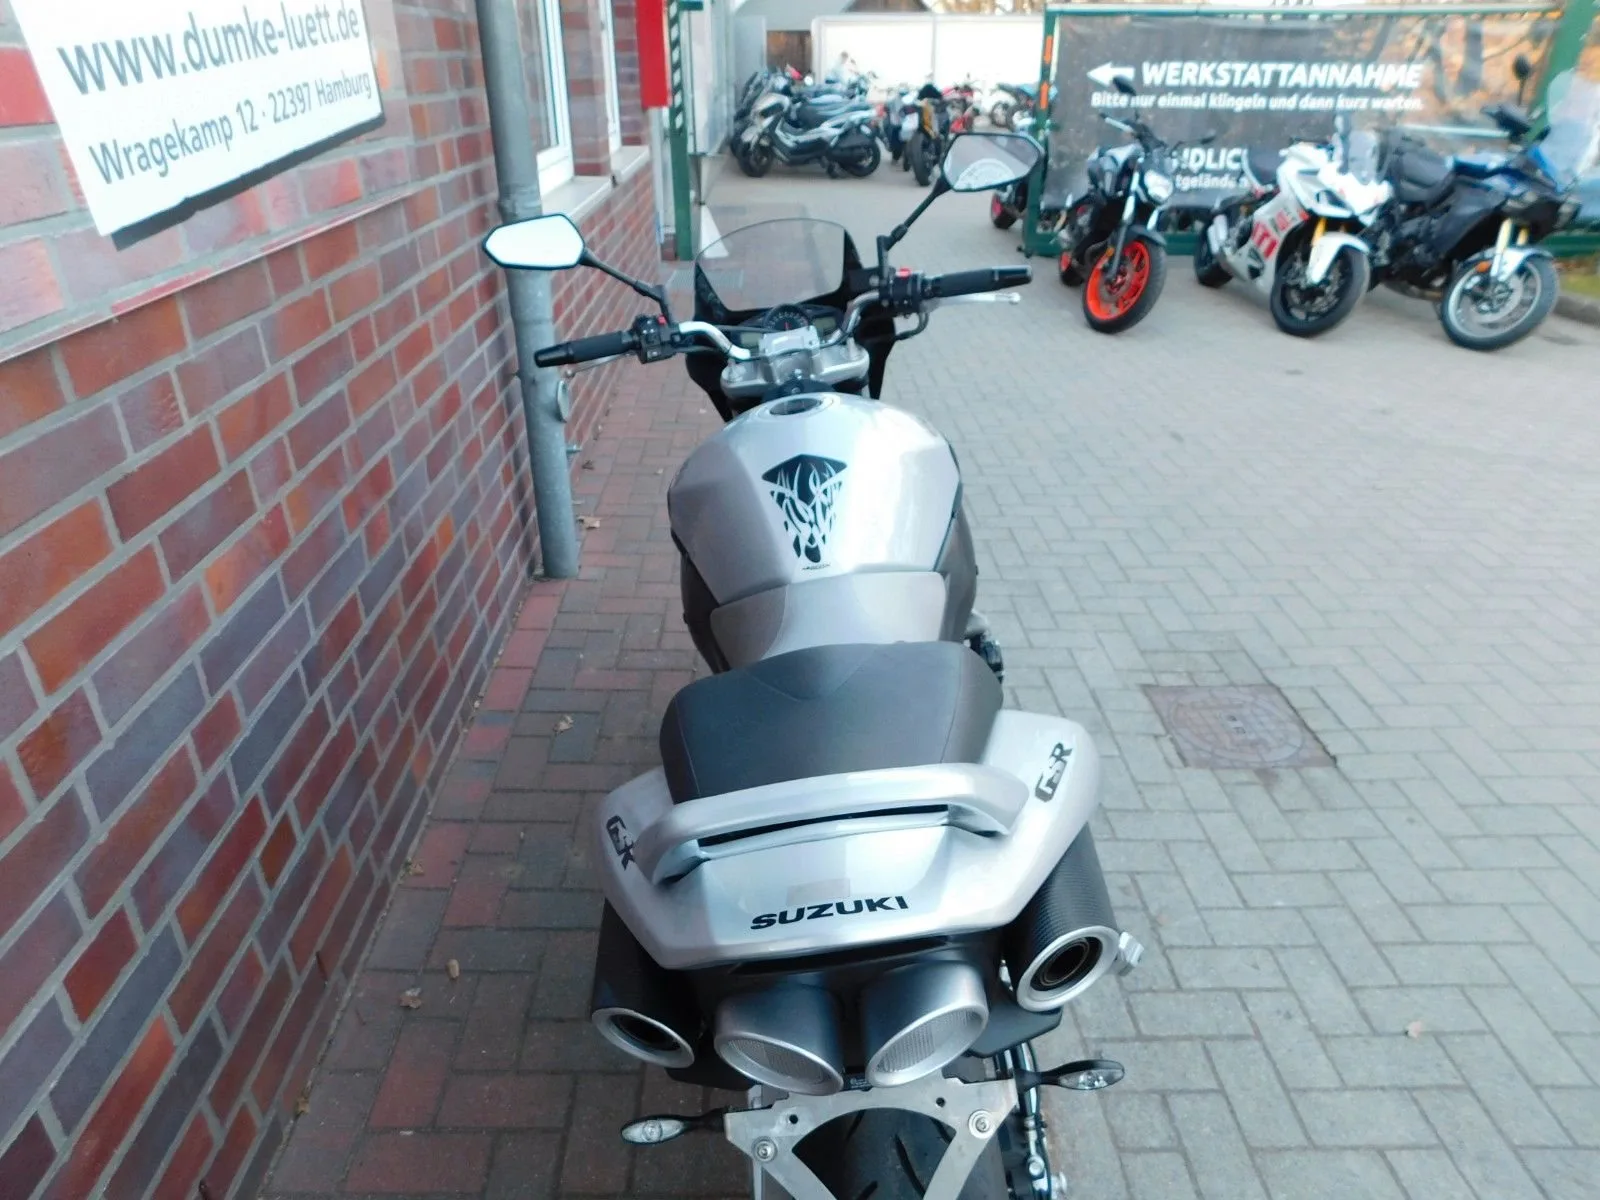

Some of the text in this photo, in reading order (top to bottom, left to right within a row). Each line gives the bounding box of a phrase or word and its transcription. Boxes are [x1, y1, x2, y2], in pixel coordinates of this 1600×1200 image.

[56, 0, 361, 95] www.dumke-luett.de
[1141, 60, 1424, 89] WERKSTATTANNAHME
[1090, 91, 1128, 108] Bitte
[1130, 93, 1156, 108] nur
[1157, 91, 1207, 109] einmal
[1208, 92, 1267, 113] klingeln
[1269, 93, 1299, 110] und
[1300, 92, 1335, 110] dann
[1336, 93, 1369, 110] kurz
[88, 117, 234, 185] Wragekamp
[235, 98, 259, 135] 12
[267, 81, 313, 124] 22397
[314, 69, 373, 108] Hamburg
[750, 895, 909, 930] SUZUKI
